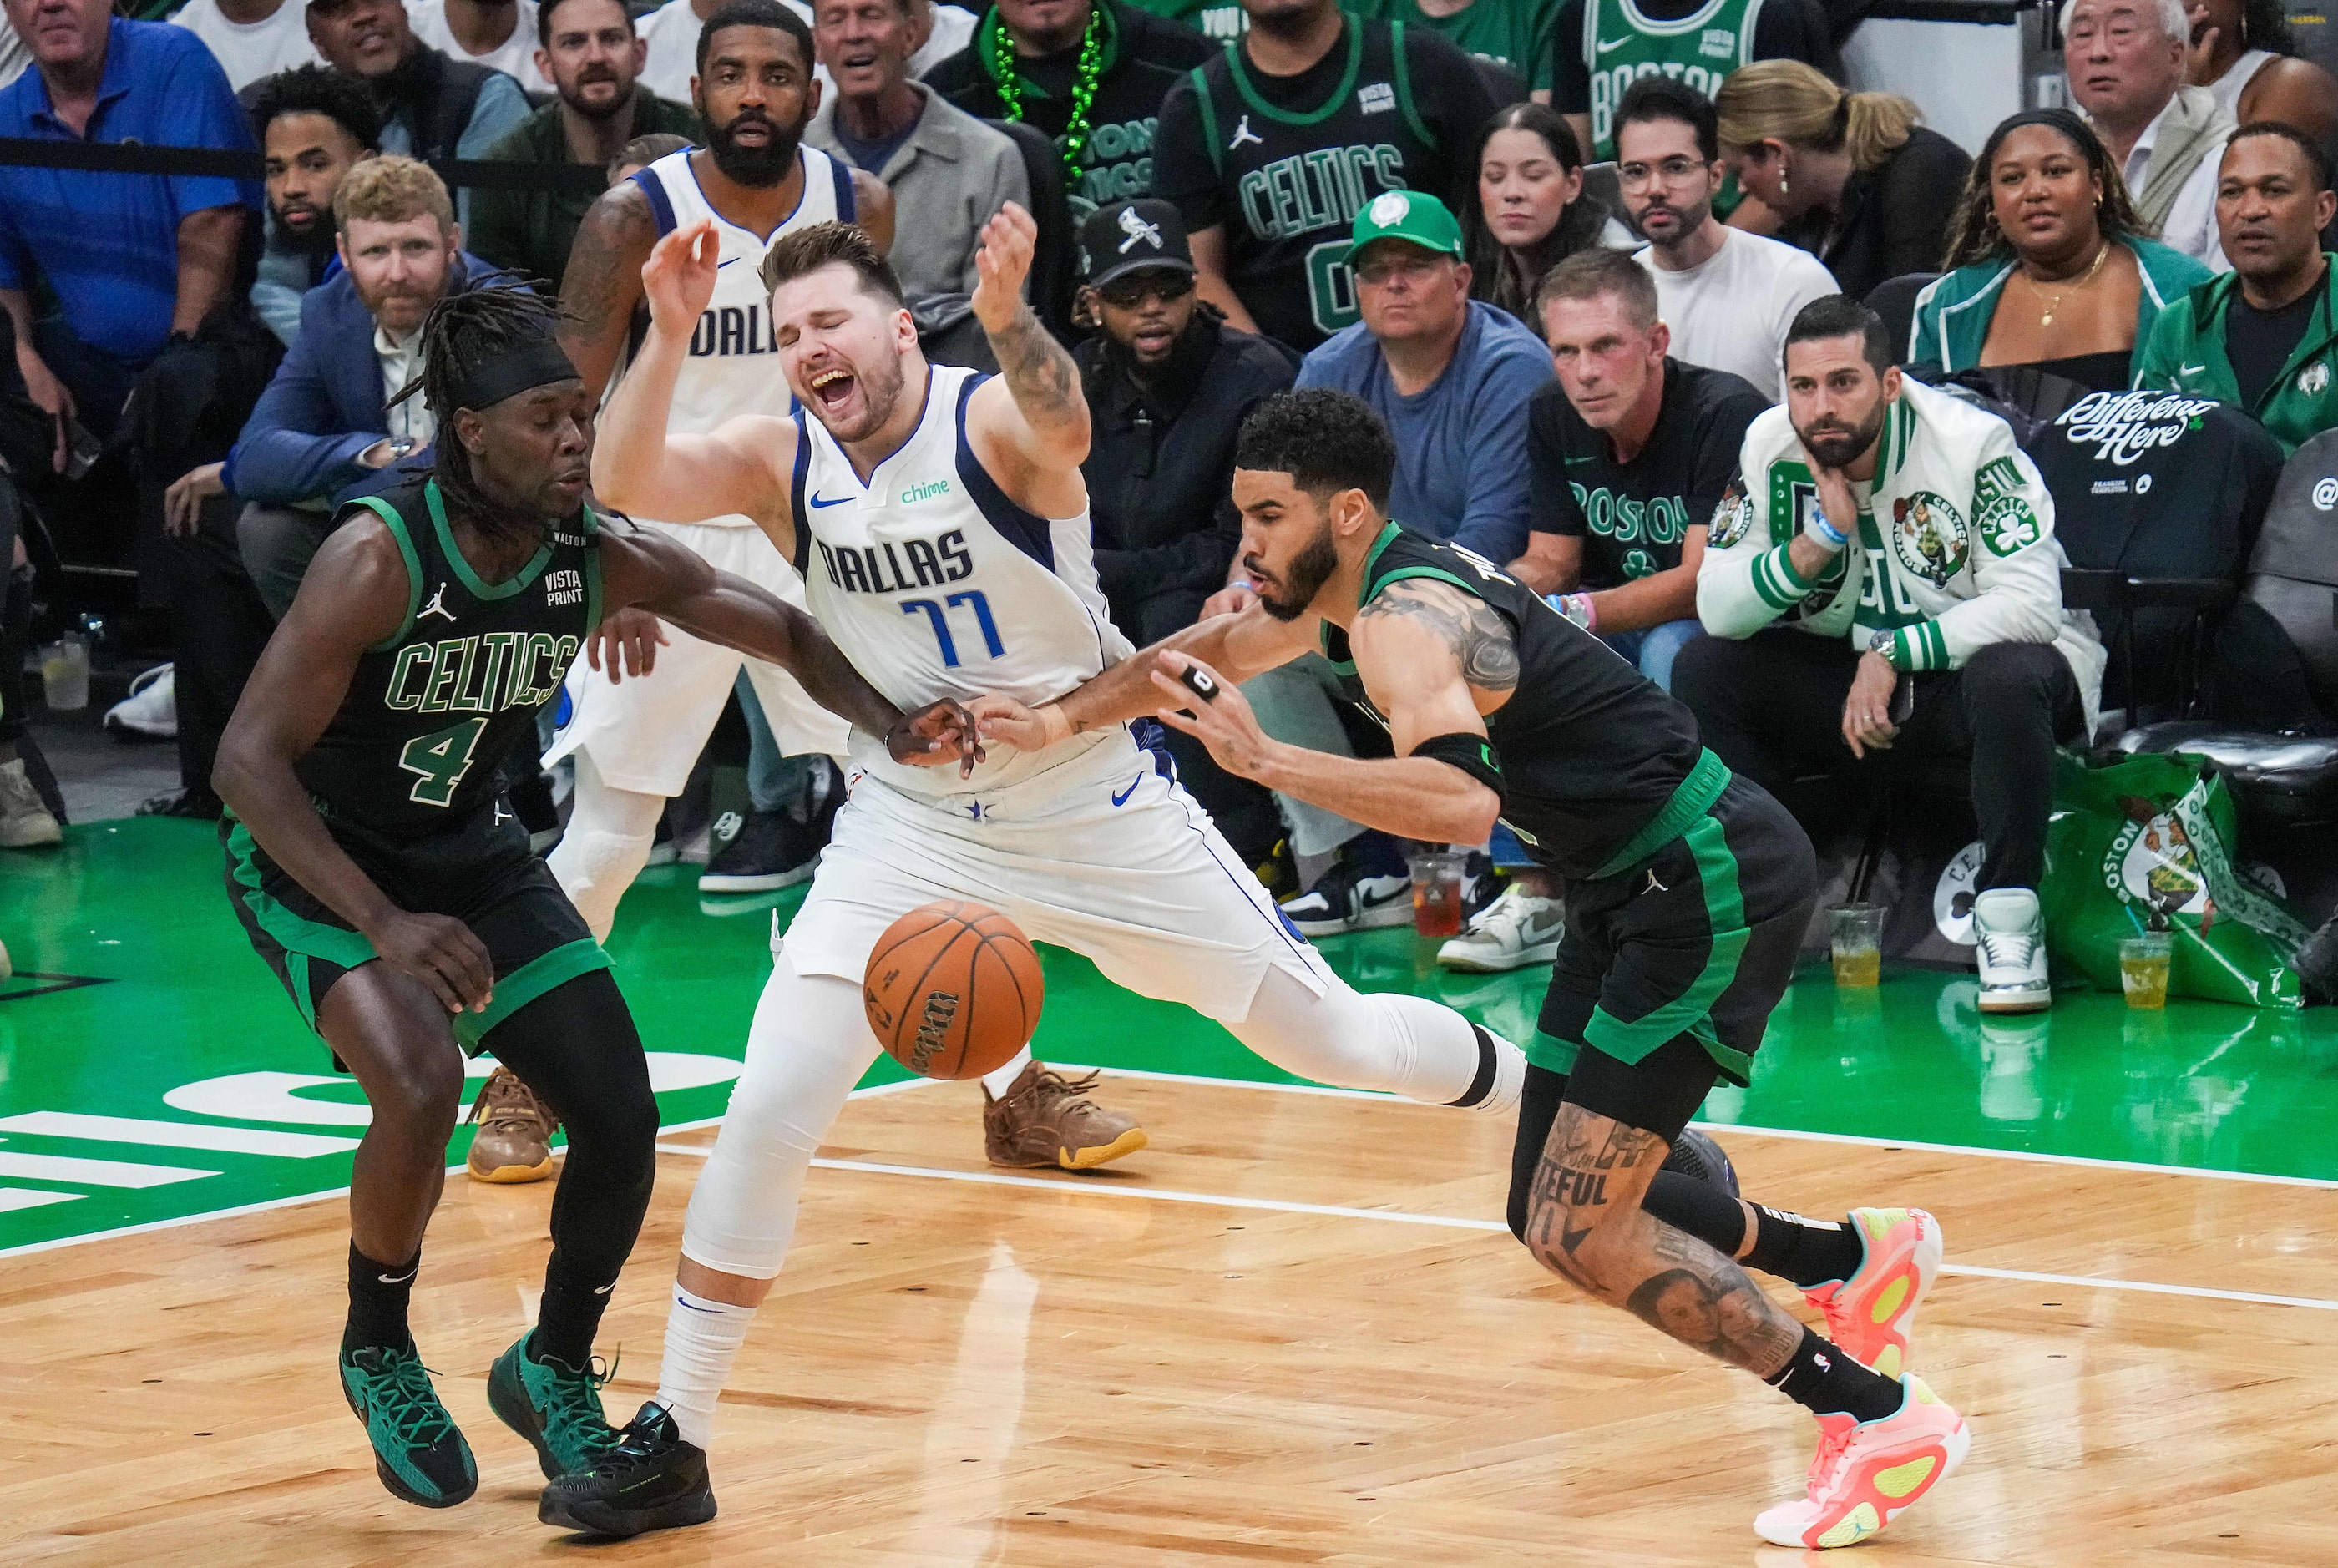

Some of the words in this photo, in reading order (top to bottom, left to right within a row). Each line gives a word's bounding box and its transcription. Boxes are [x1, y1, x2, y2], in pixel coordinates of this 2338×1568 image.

[1239, 144, 1408, 240] CELTICS
[2053, 390, 2220, 443] Different
[2093, 415, 2189, 466] Here
[902, 479, 950, 504] chime
[1981, 498, 2032, 534] CELTICS
[554, 531, 587, 547] WALTON
[816, 527, 974, 594] DALLAS
[545, 569, 582, 592] VISTA
[546, 589, 583, 607] PRINT
[898, 589, 1007, 668] 77
[384, 631, 579, 713] CELTICS
[1193, 670, 1213, 691] 0
[398, 716, 489, 808] 4
